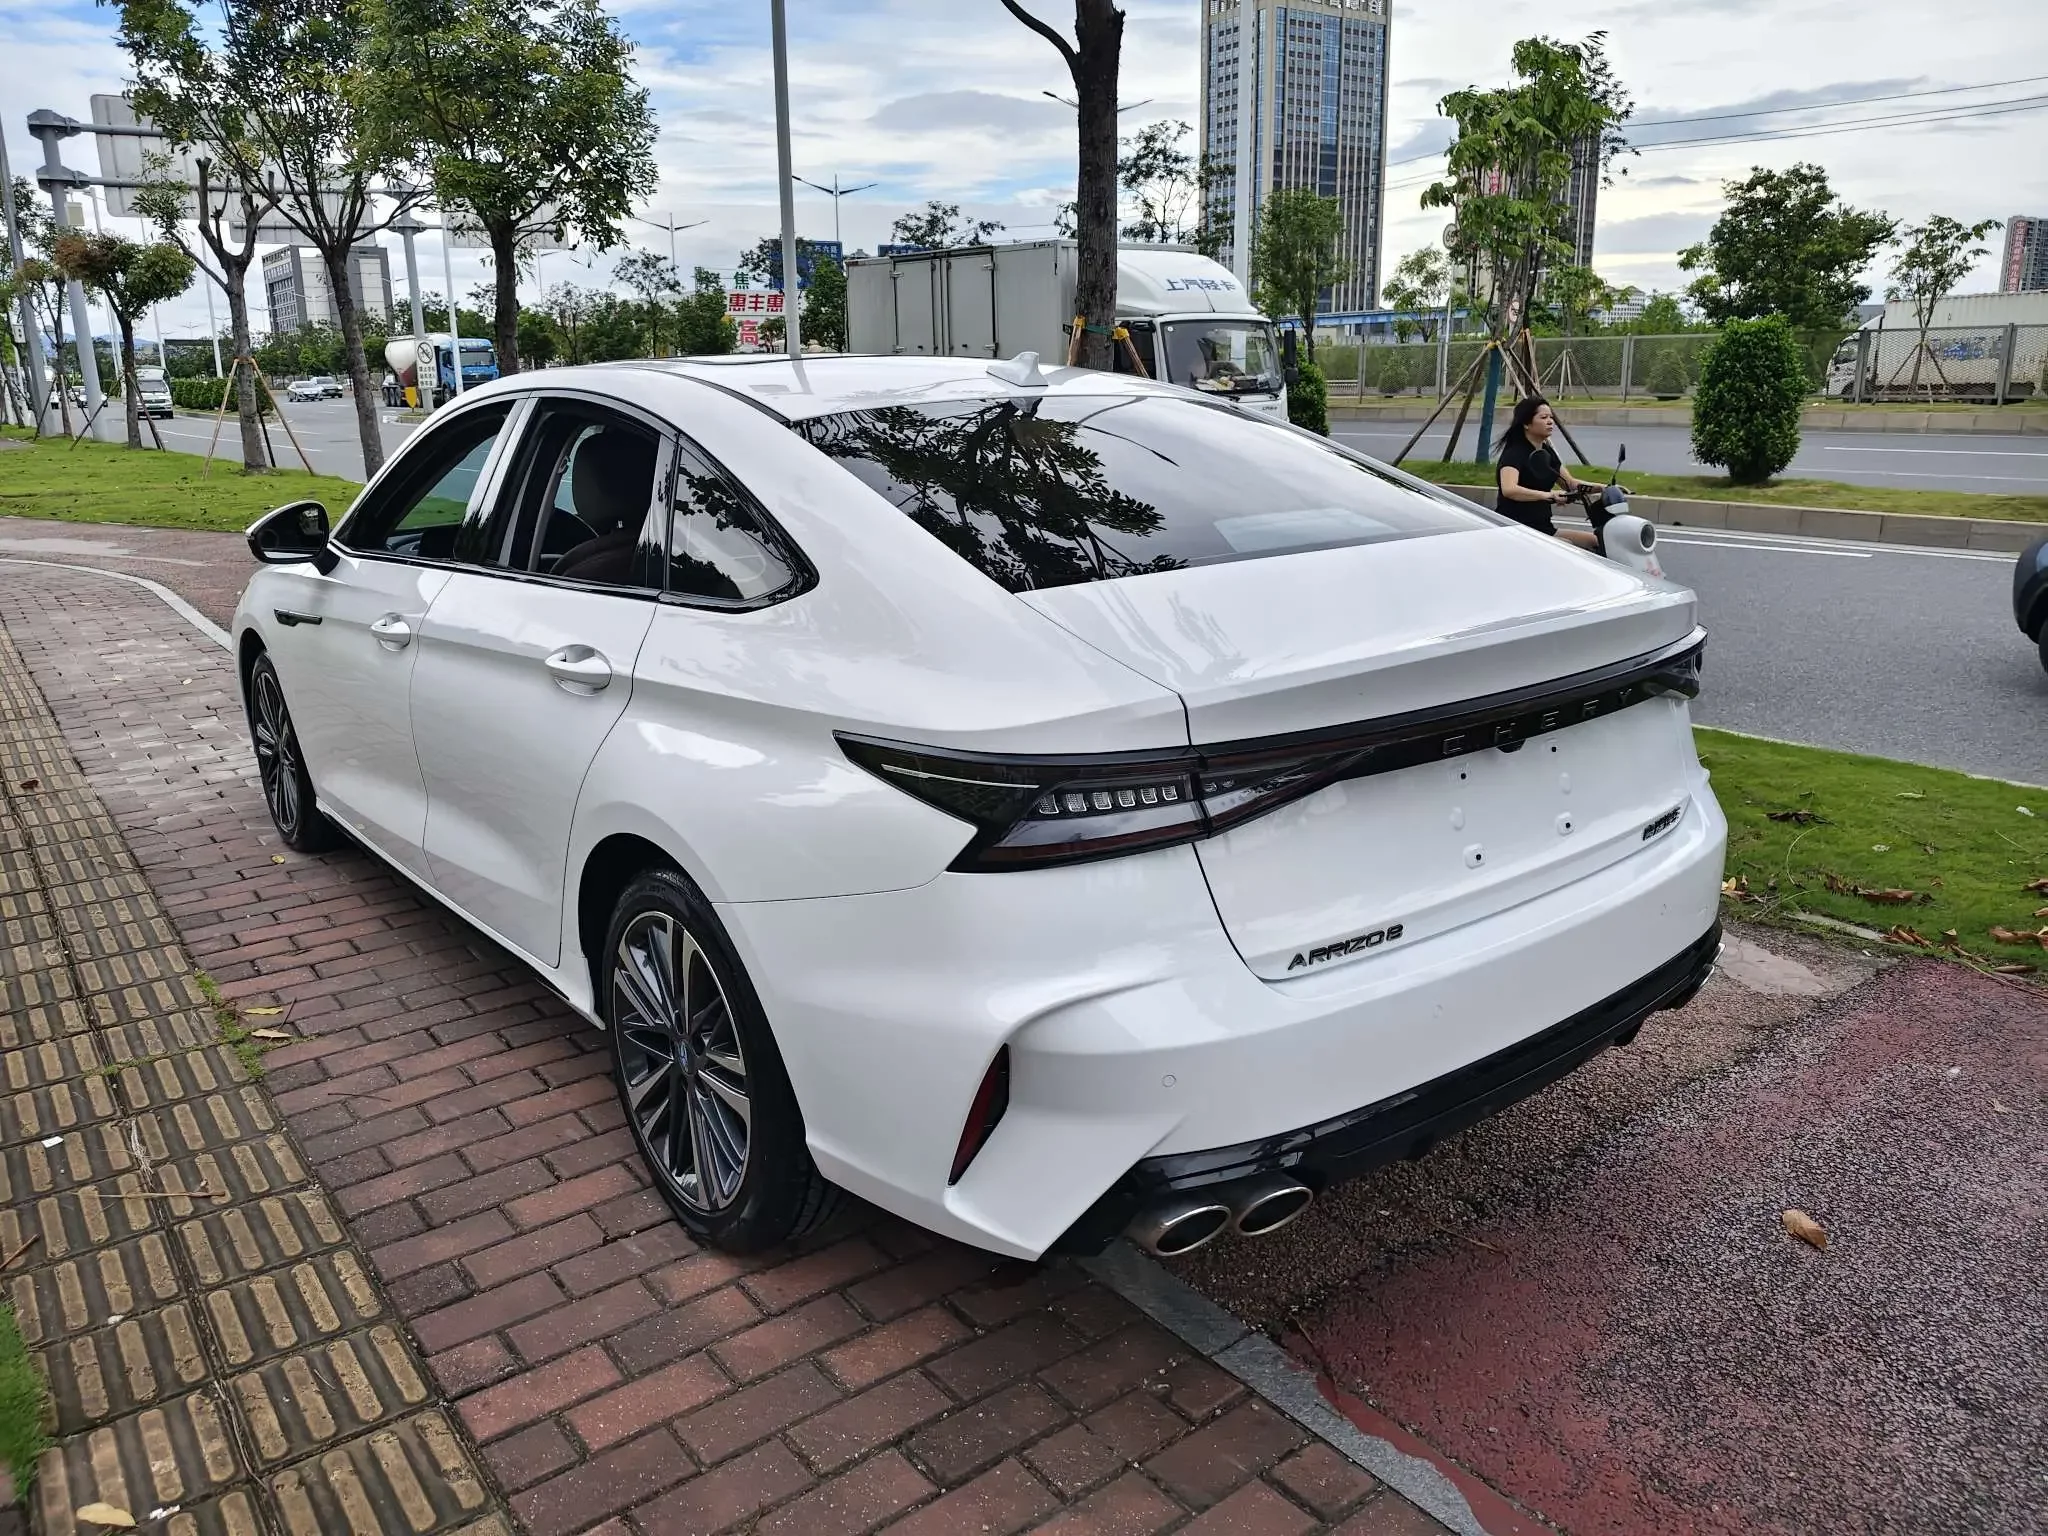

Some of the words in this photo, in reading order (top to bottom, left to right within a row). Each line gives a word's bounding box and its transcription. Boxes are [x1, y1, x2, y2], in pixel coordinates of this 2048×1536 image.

[1166, 278, 1236, 291] 上汽轻卡
[728, 293, 801, 313] 惠丰惠
[1443, 688, 1634, 755] CHERY
[1287, 929, 1385, 970] ARRIZO
